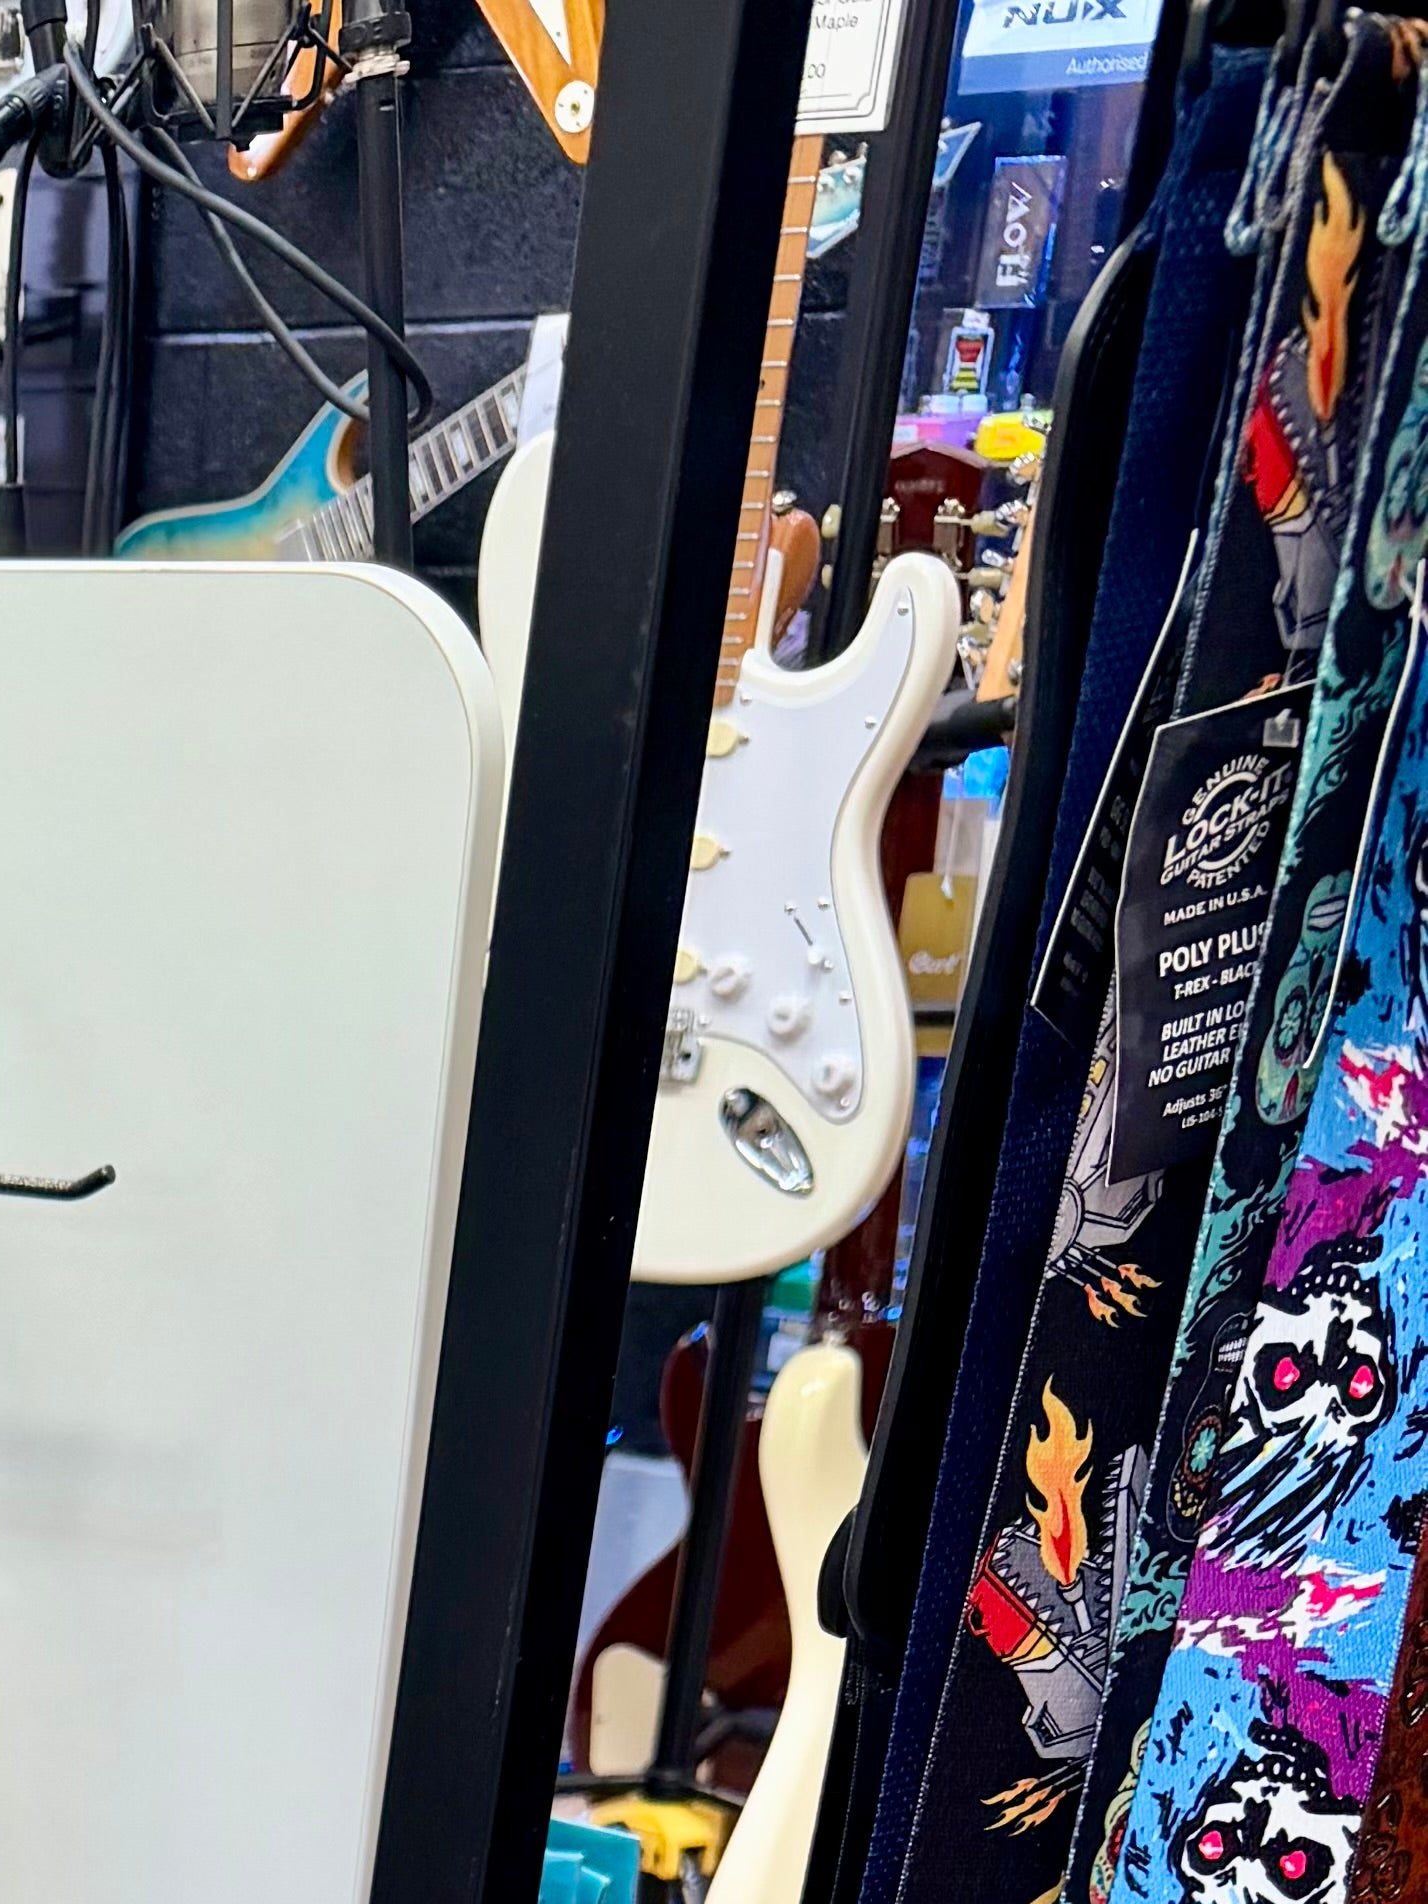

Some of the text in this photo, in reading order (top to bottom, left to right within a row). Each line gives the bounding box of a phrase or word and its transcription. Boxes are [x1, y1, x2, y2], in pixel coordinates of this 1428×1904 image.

[1182, 754, 1271, 825] GENUINE
[1164, 760, 1292, 868] LOCK-IT
[1160, 834, 1222, 885] GUITAR
[1186, 821, 1271, 888] PATENTED
[1163, 885, 1268, 926] MADE IN U.S.A.
[1158, 938, 1214, 978] POLY
[1174, 974, 1211, 1000] T-REX
[1220, 961, 1256, 987] BLAC
[1161, 1012, 1204, 1042] BUILT
[1206, 1008, 1223, 1028] IN
[1163, 1028, 1226, 1063] LEATHER
[1148, 1047, 1232, 1087] NO GUITAR
[1162, 1093, 1207, 1118] Adjusts
